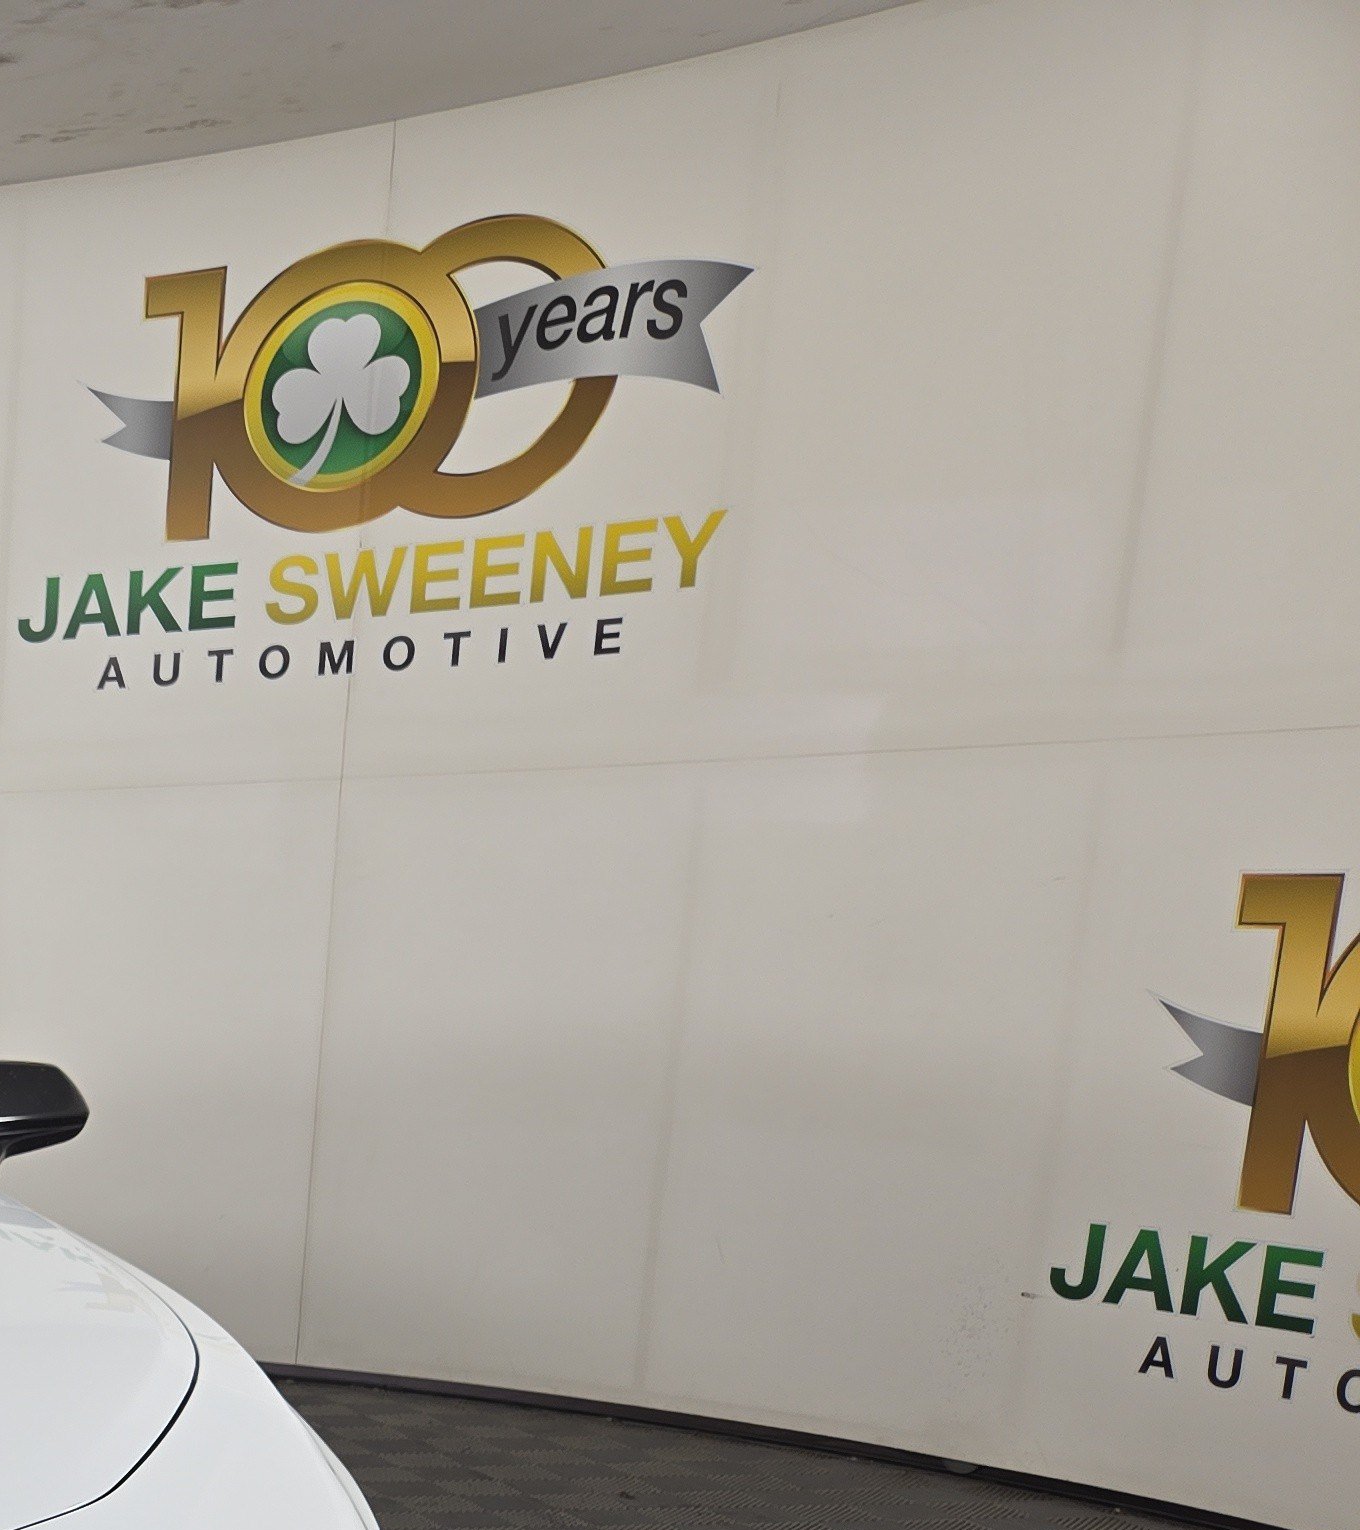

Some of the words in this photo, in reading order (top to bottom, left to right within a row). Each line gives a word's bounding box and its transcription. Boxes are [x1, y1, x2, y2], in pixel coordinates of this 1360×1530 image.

[144, 213, 620, 543] 100
[491, 275, 688, 382] years
[17, 562, 239, 643] JAKE
[265, 510, 728, 625] SWEENEY
[97, 617, 623, 691] AUTOMOTIVE
[1049, 1223, 1325, 1336] JAKE
